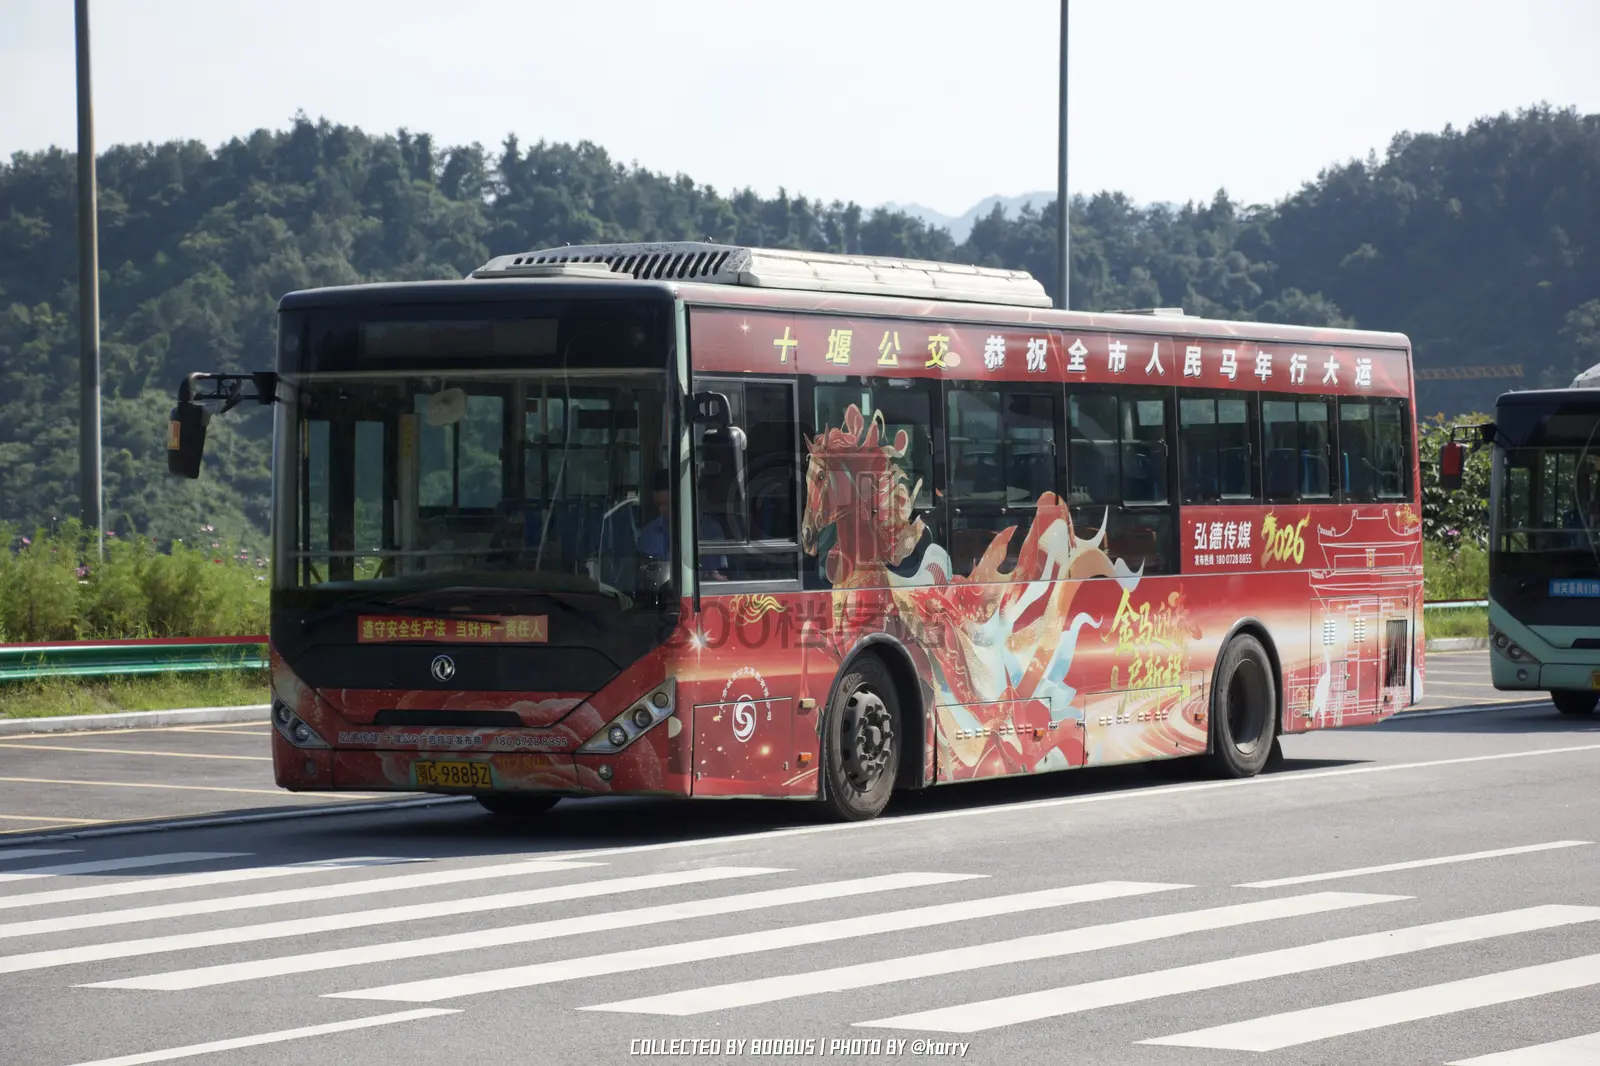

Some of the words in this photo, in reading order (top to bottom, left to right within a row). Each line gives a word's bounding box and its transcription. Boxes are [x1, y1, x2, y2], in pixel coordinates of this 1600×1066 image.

[773, 326, 950, 369] 十堰公交
[984, 334, 1373, 388] 恭祝全市人民马年行大运
[1194, 521, 1252, 550] 弘德传媒
[1261, 510, 1309, 568] 2026
[1195, 555, 1214, 566] 发布热线
[362, 620, 446, 639] 遵守安全生产法
[456, 620, 543, 639] 当好第一责任人
